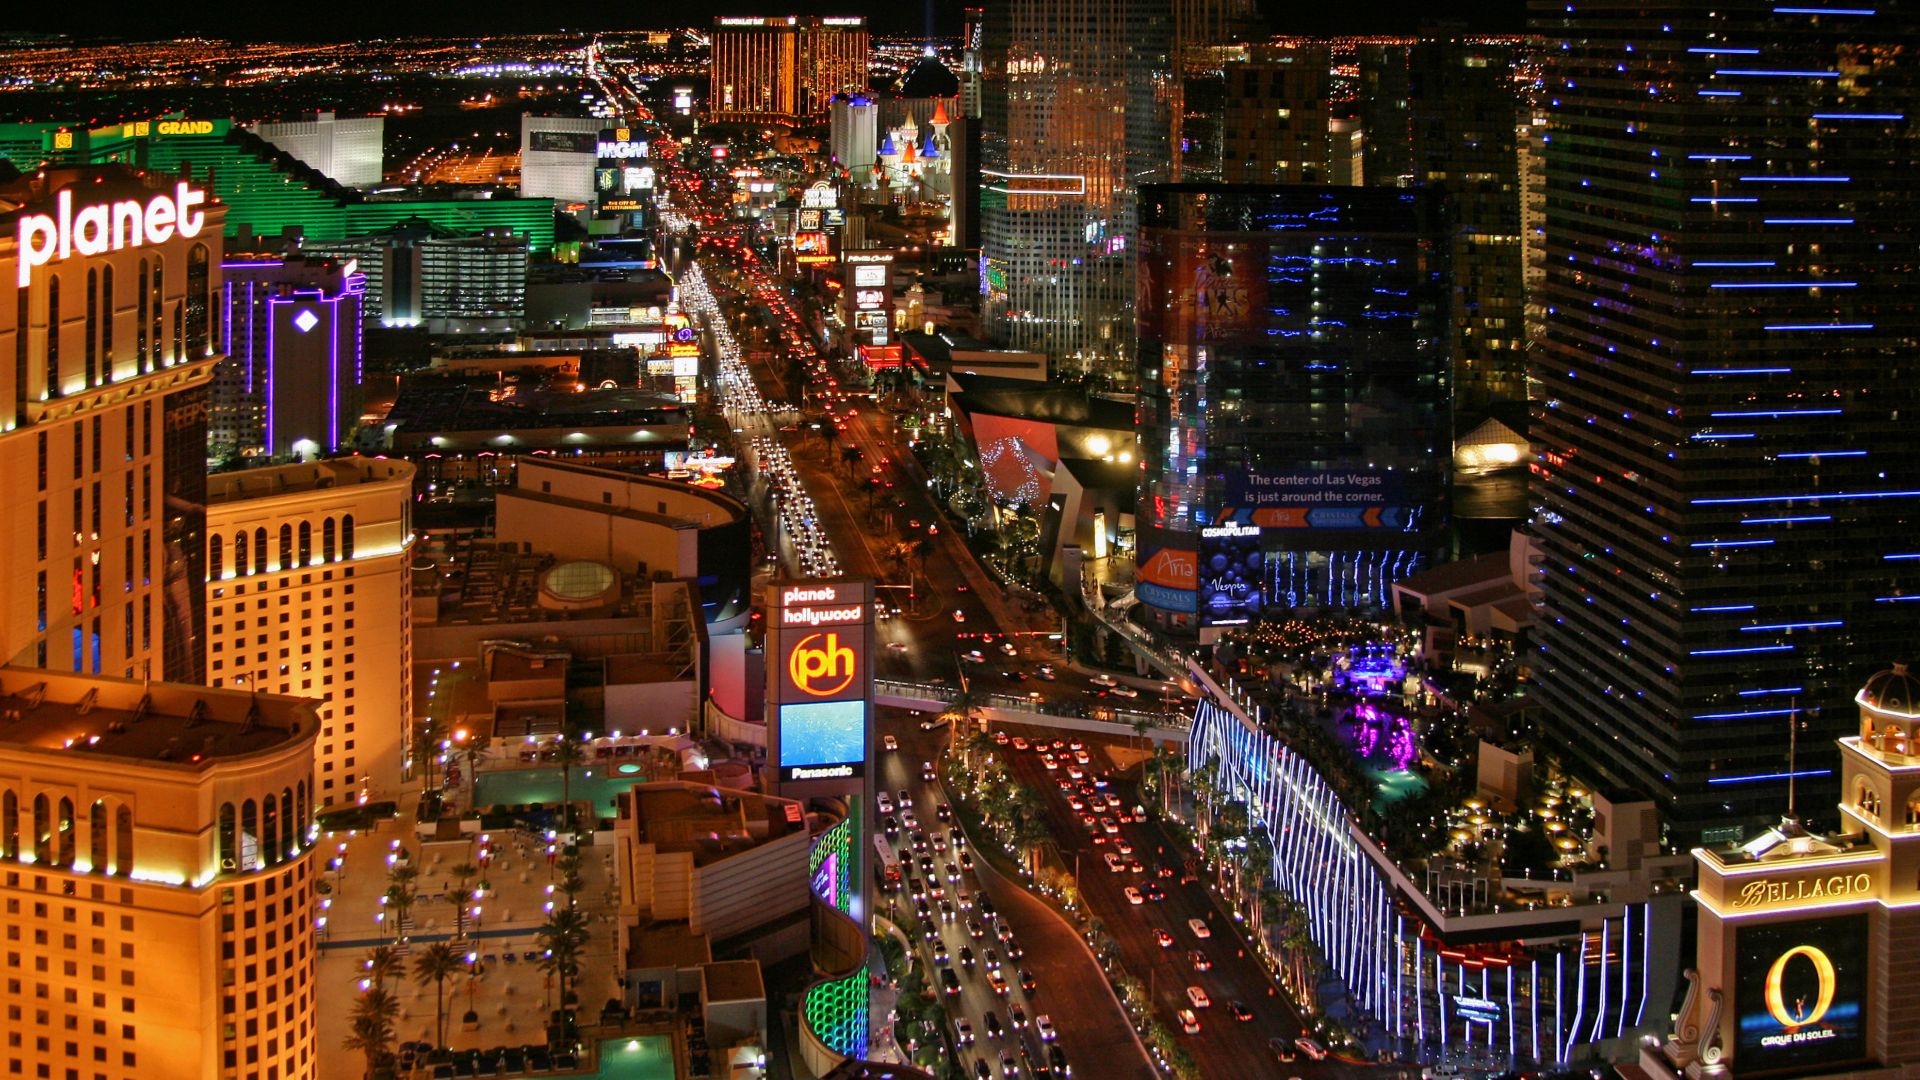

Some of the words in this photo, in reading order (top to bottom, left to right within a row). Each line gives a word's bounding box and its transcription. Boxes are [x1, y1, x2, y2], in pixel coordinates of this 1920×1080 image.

[158, 121, 213, 134] GRAND
[597, 141, 648, 158] MGM
[17, 182, 205, 288] planet
[1248, 474, 1271, 485] The
[1273, 475, 1309, 485] center
[1312, 474, 1324, 485] of
[1327, 475, 1346, 485] Las
[1347, 475, 1382, 488] Vegas
[1245, 491, 1255, 502] is
[1257, 491, 1279, 503] just
[1281, 491, 1322, 502] around
[1324, 491, 1344, 502] the
[1345, 493, 1385, 502] corner.
[1202, 526, 1260, 537] COSMOPOLITAN
[783, 587, 835, 606] planet
[783, 606, 862, 627] hollywood
[791, 765, 853, 779] Panasonic
[1732, 873, 1871, 908] BELLAGIO
[1764, 945, 1836, 1027] O
[1760, 1034, 1792, 1047] CIRQUE
[1793, 1032, 1806, 1042] DU
[1806, 1029, 1836, 1040] SOLEIL
